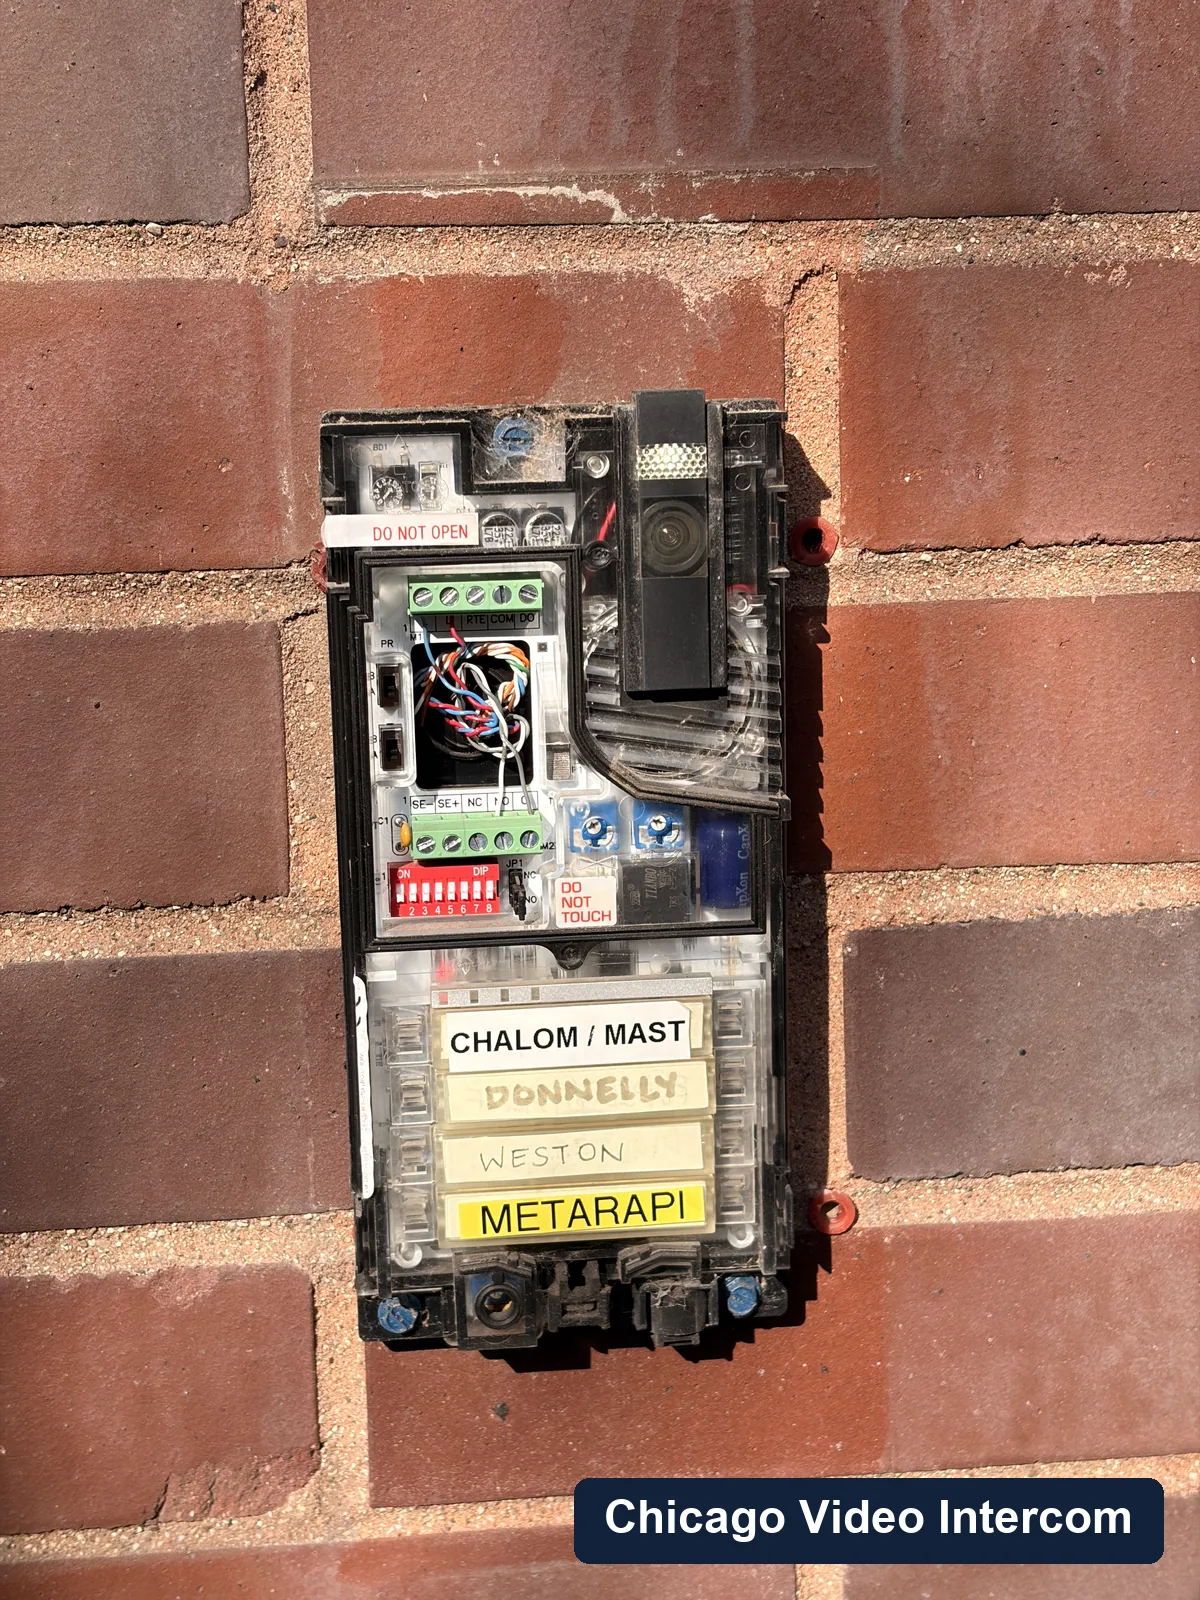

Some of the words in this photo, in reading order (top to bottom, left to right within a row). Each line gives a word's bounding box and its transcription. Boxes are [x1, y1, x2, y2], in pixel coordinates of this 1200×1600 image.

[373, 443, 388, 451] BD1
[373, 526, 392, 541] DO
[398, 525, 426, 541] NOT
[431, 524, 468, 539] OPEN
[467, 614, 486, 625] RTE
[490, 613, 514, 624] COM
[519, 612, 535, 622] DO
[381, 639, 394, 648] PR
[412, 800, 434, 810] SE-
[437, 799, 459, 808] SE+
[467, 797, 483, 807] NC
[506, 859, 523, 868] JP1
[397, 869, 411, 879] ON
[473, 866, 489, 876] DIP
[523, 870, 537, 879] NC
[561, 881, 582, 894] DO
[561, 896, 592, 908] NOT
[409, 907, 415, 916] 2
[422, 906, 428, 915] 3
[435, 905, 441, 914] 4
[447, 905, 453, 914] 5
[460, 905, 467, 914] 6
[473, 904, 479, 913] 7
[486, 903, 492, 912] 8
[561, 910, 612, 923] TOUCH
[450, 1026, 578, 1054] CHALOM
[587, 1025, 595, 1047] /
[605, 1020, 685, 1046] MAST
[485, 1071, 678, 1110] DONNELLY
[480, 1142, 624, 1172] WESTON
[481, 1190, 685, 1235] METARAPI
